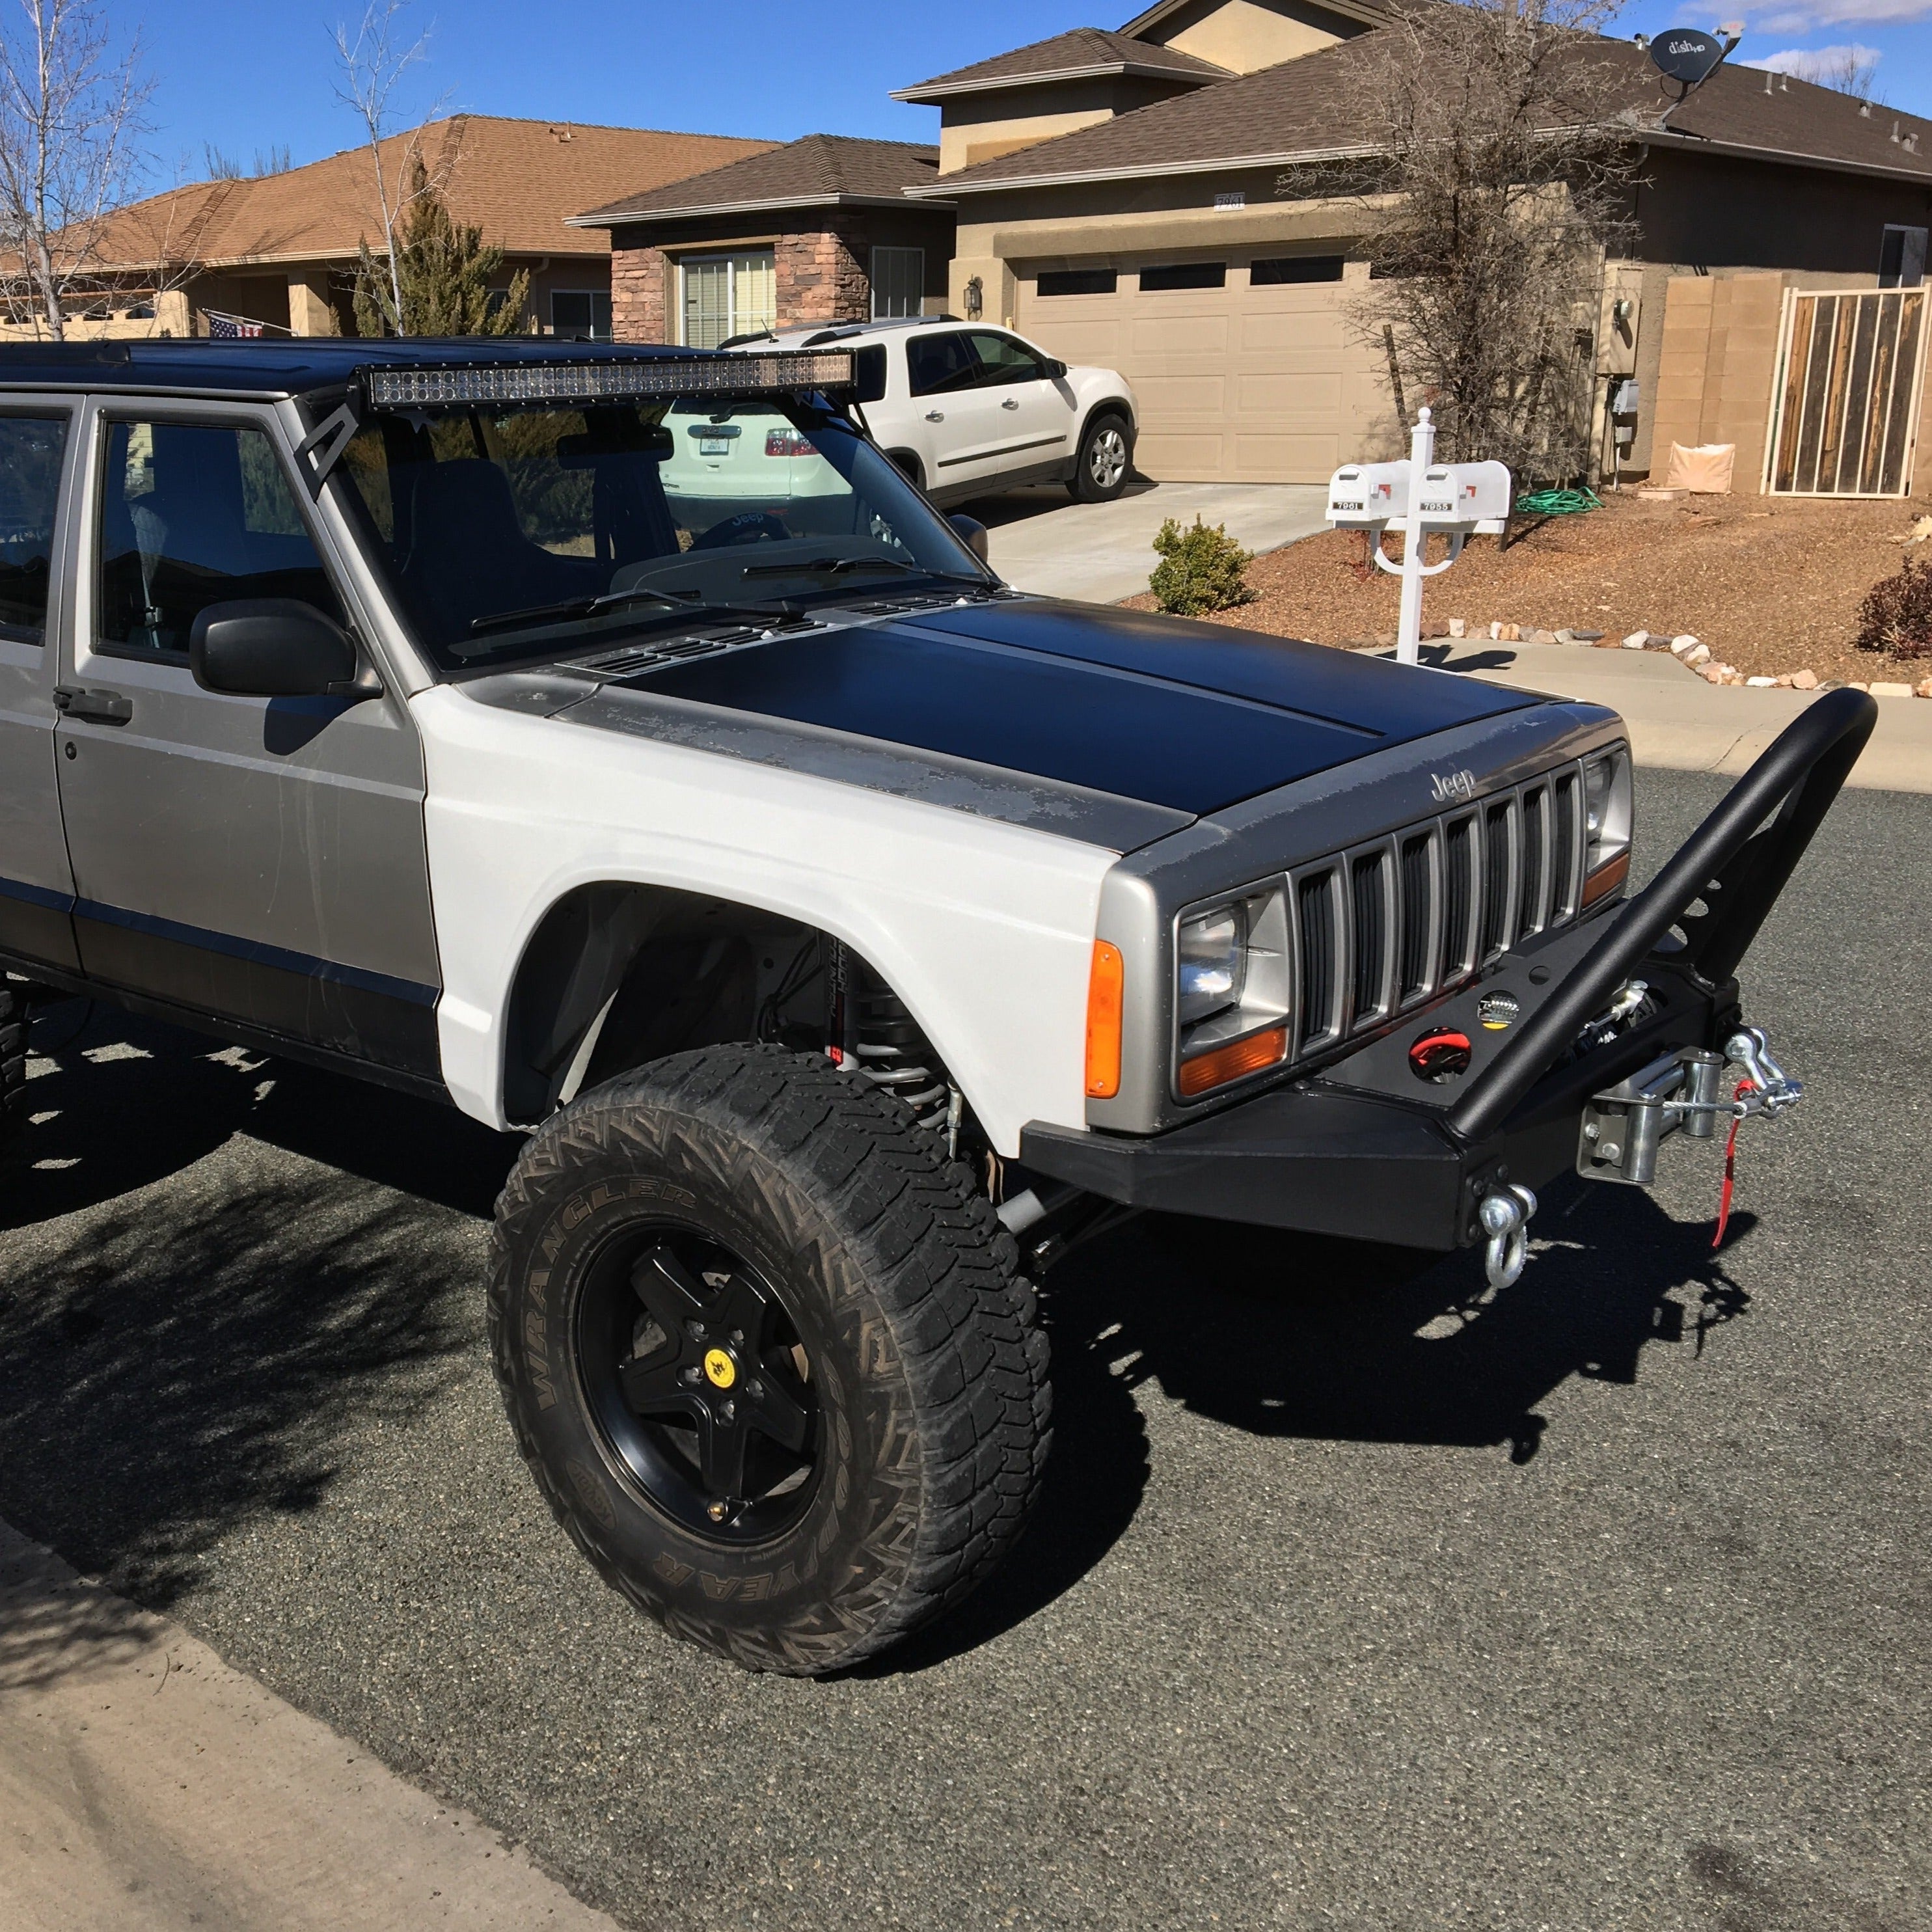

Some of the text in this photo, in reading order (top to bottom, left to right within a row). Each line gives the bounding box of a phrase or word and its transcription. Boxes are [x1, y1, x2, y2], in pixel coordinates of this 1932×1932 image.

[1218, 197, 1242, 208] 7961
[1337, 502, 1358, 510] 7961
[1424, 502, 1449, 511] 7955
[732, 513, 763, 526] Jeep
[1430, 769, 1478, 802] Jeep
[837, 941, 847, 994] OUGH
[525, 1178, 698, 1411] WRANGLER
